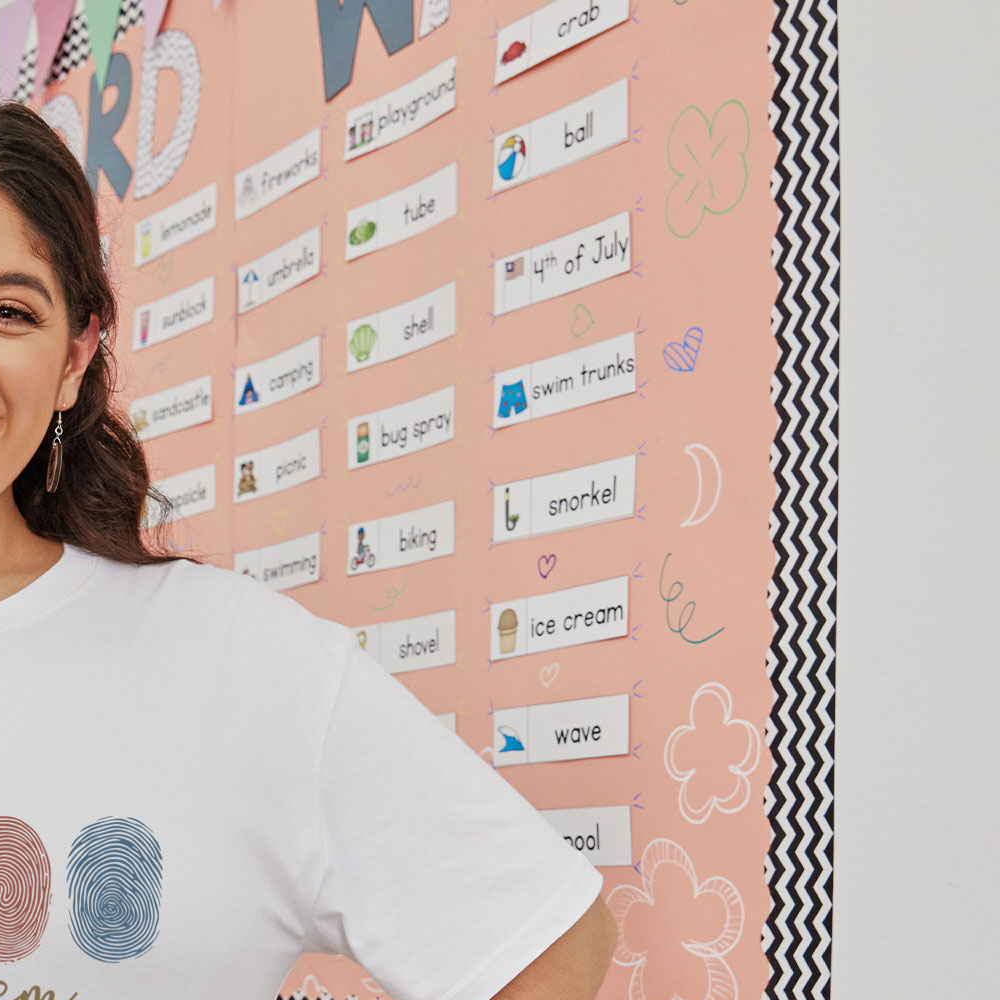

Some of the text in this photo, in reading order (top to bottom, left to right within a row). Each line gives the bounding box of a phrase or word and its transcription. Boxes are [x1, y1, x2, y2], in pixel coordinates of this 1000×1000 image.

[557, 0, 600, 38] crab
[377, 65, 456, 136] playground
[564, 110, 594, 148] ball
[262, 147, 317, 193] fireworks
[161, 199, 212, 241] lemonade
[404, 195, 436, 225] tube
[267, 247, 315, 287] umbrella
[533, 230, 629, 283] 4th of July
[162, 294, 207, 330] sunblock
[404, 306, 434, 341] shell
[269, 362, 313, 393] camping
[532, 352, 635, 400] swim trunks
[152, 388, 210, 422] sandcastle
[381, 411, 452, 449] bug spray
[275, 455, 308, 486] picnic
[549, 475, 617, 516] snorkel
[399, 526, 437, 552] biking
[263, 554, 317, 583] swimming
[531, 605, 623, 638] ice cream
[399, 627, 439, 659] shovel
[555, 715, 602, 745] wave
